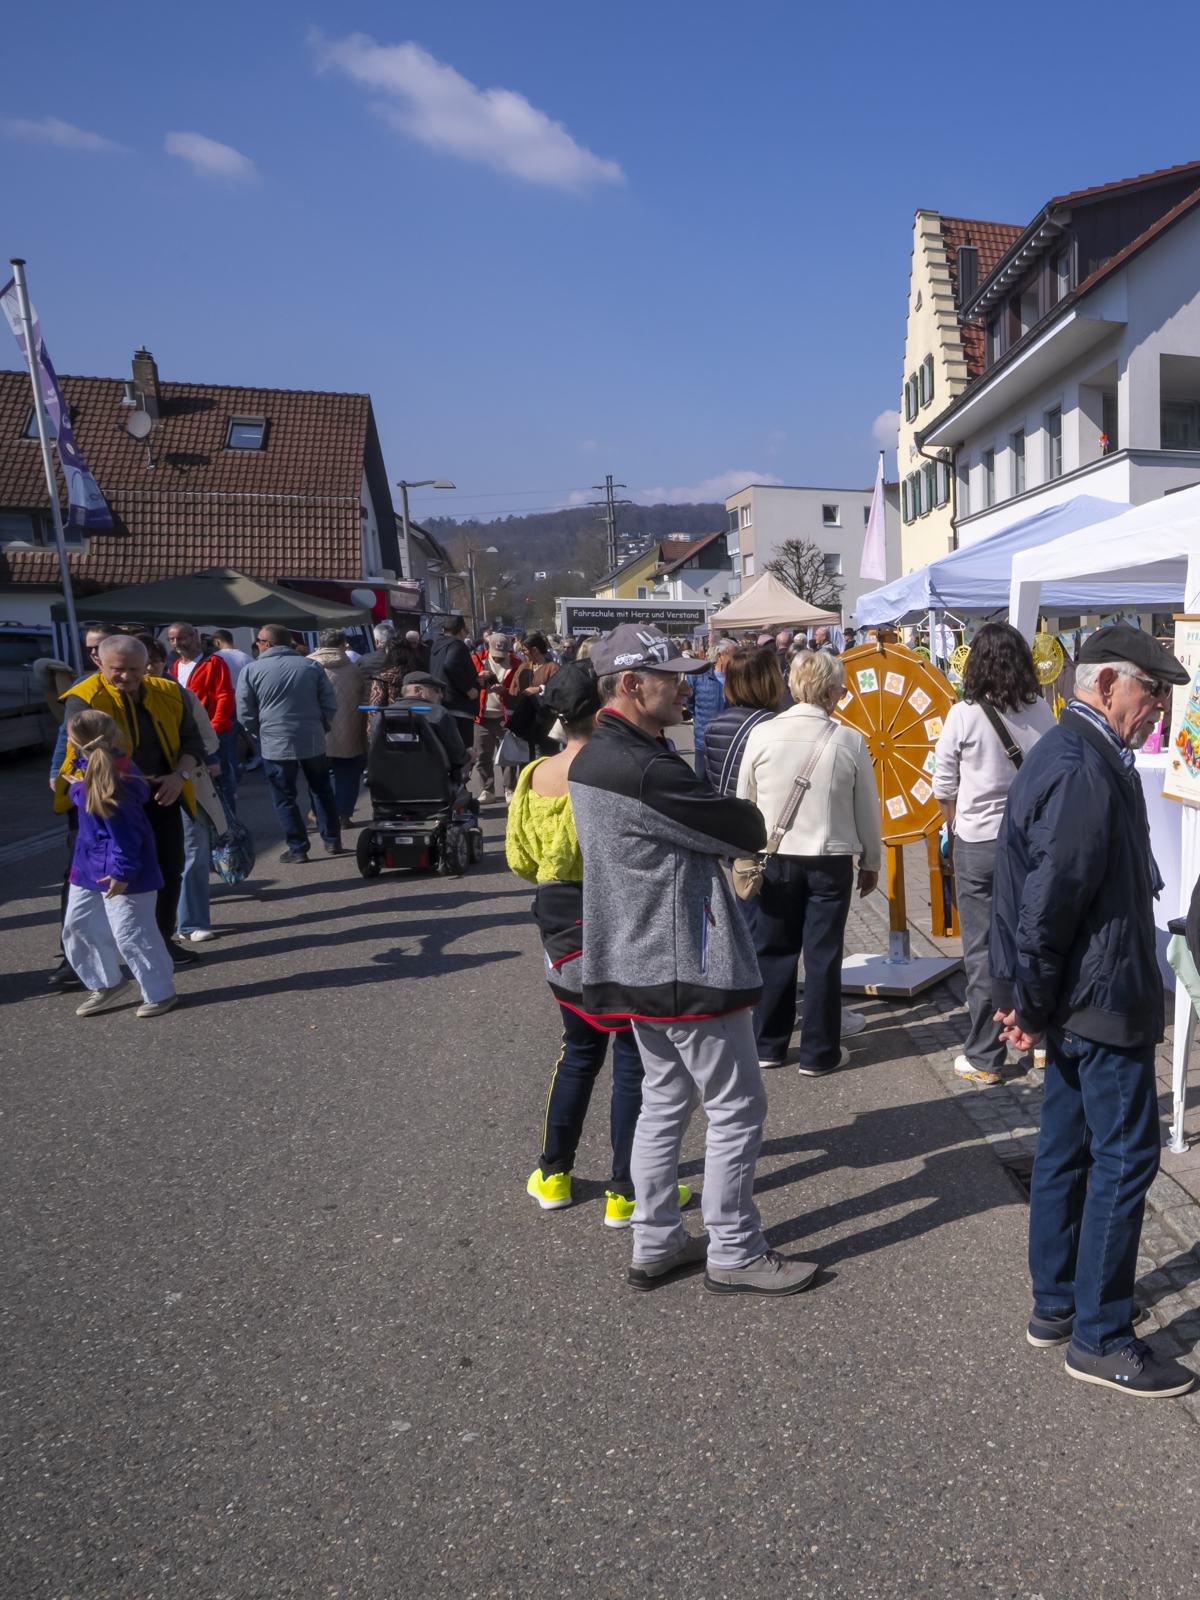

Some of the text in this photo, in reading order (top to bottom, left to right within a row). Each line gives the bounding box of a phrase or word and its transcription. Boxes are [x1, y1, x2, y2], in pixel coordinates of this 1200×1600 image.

[573, 609, 699, 619] Fahrschule mit Herz und Verstand
